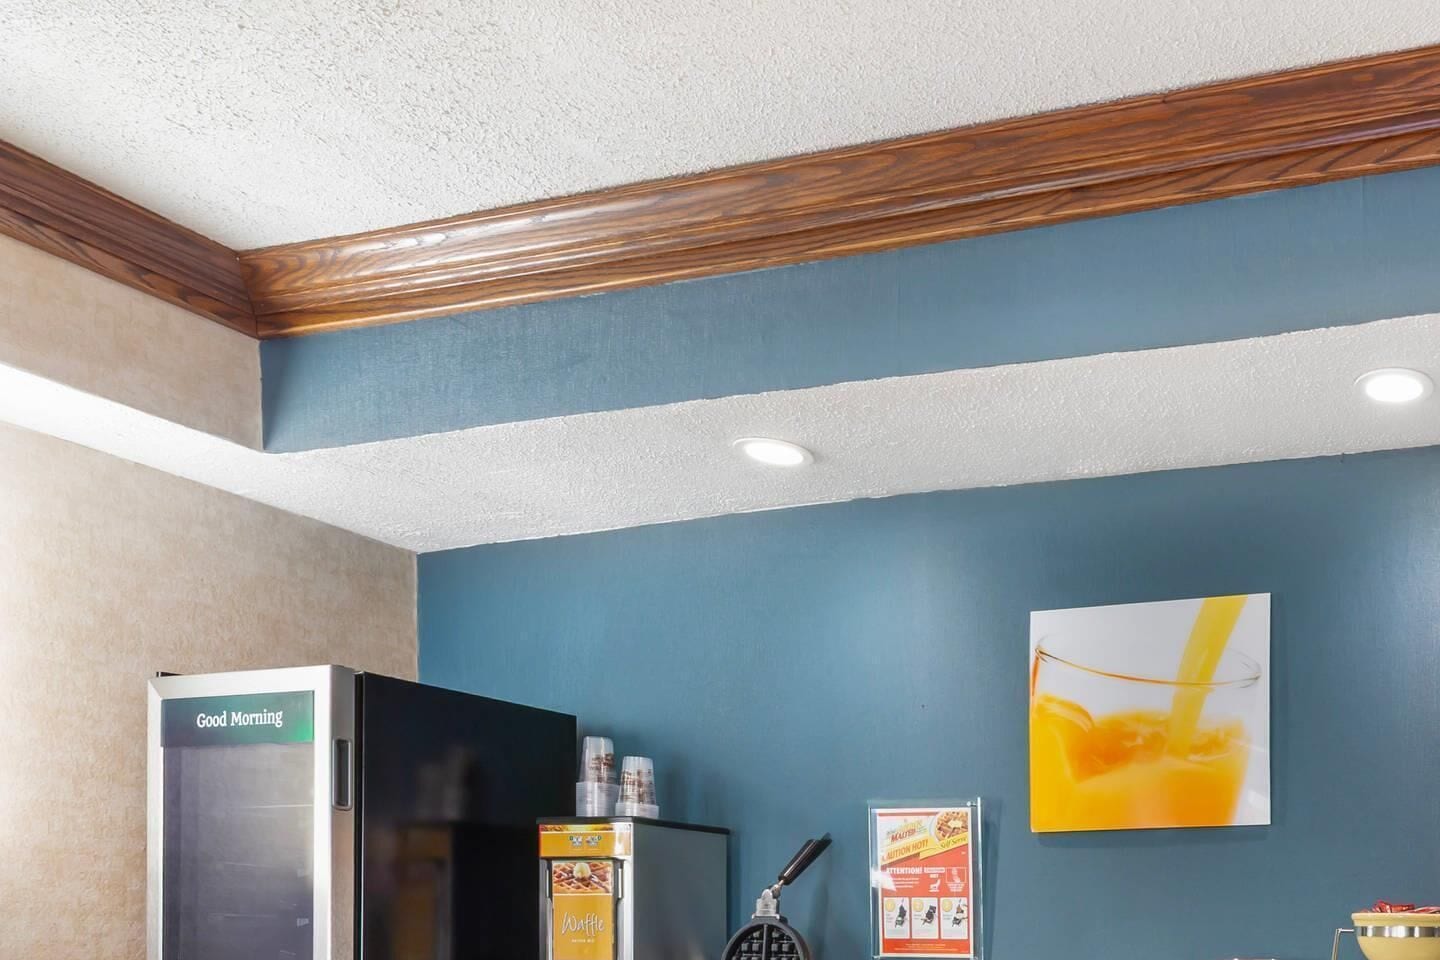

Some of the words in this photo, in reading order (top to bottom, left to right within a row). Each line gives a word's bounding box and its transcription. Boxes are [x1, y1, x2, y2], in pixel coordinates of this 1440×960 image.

[196, 710, 227, 728] Good
[230, 708, 283, 728] Morning
[561, 911, 604, 937] Waffle
